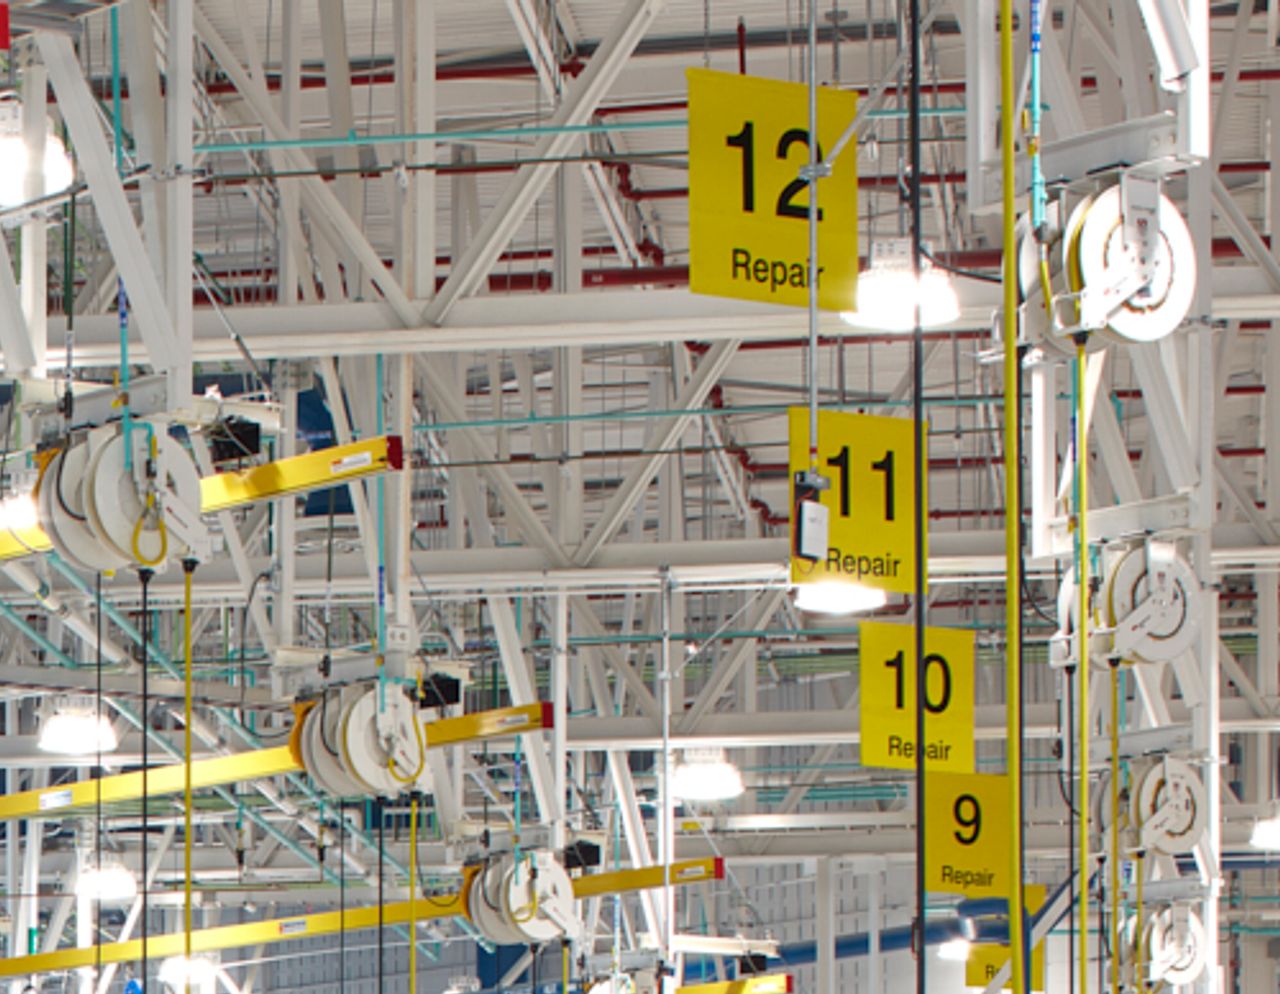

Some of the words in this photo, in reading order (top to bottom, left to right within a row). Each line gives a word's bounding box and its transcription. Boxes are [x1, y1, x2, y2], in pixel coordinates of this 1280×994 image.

[726, 121, 823, 221] 12
[732, 247, 824, 292] Repair
[827, 445, 894, 521] 11
[826, 547, 901, 580] Repair
[884, 650, 952, 714] 10
[953, 794, 981, 845] 9
[941, 864, 995, 890] Repair
